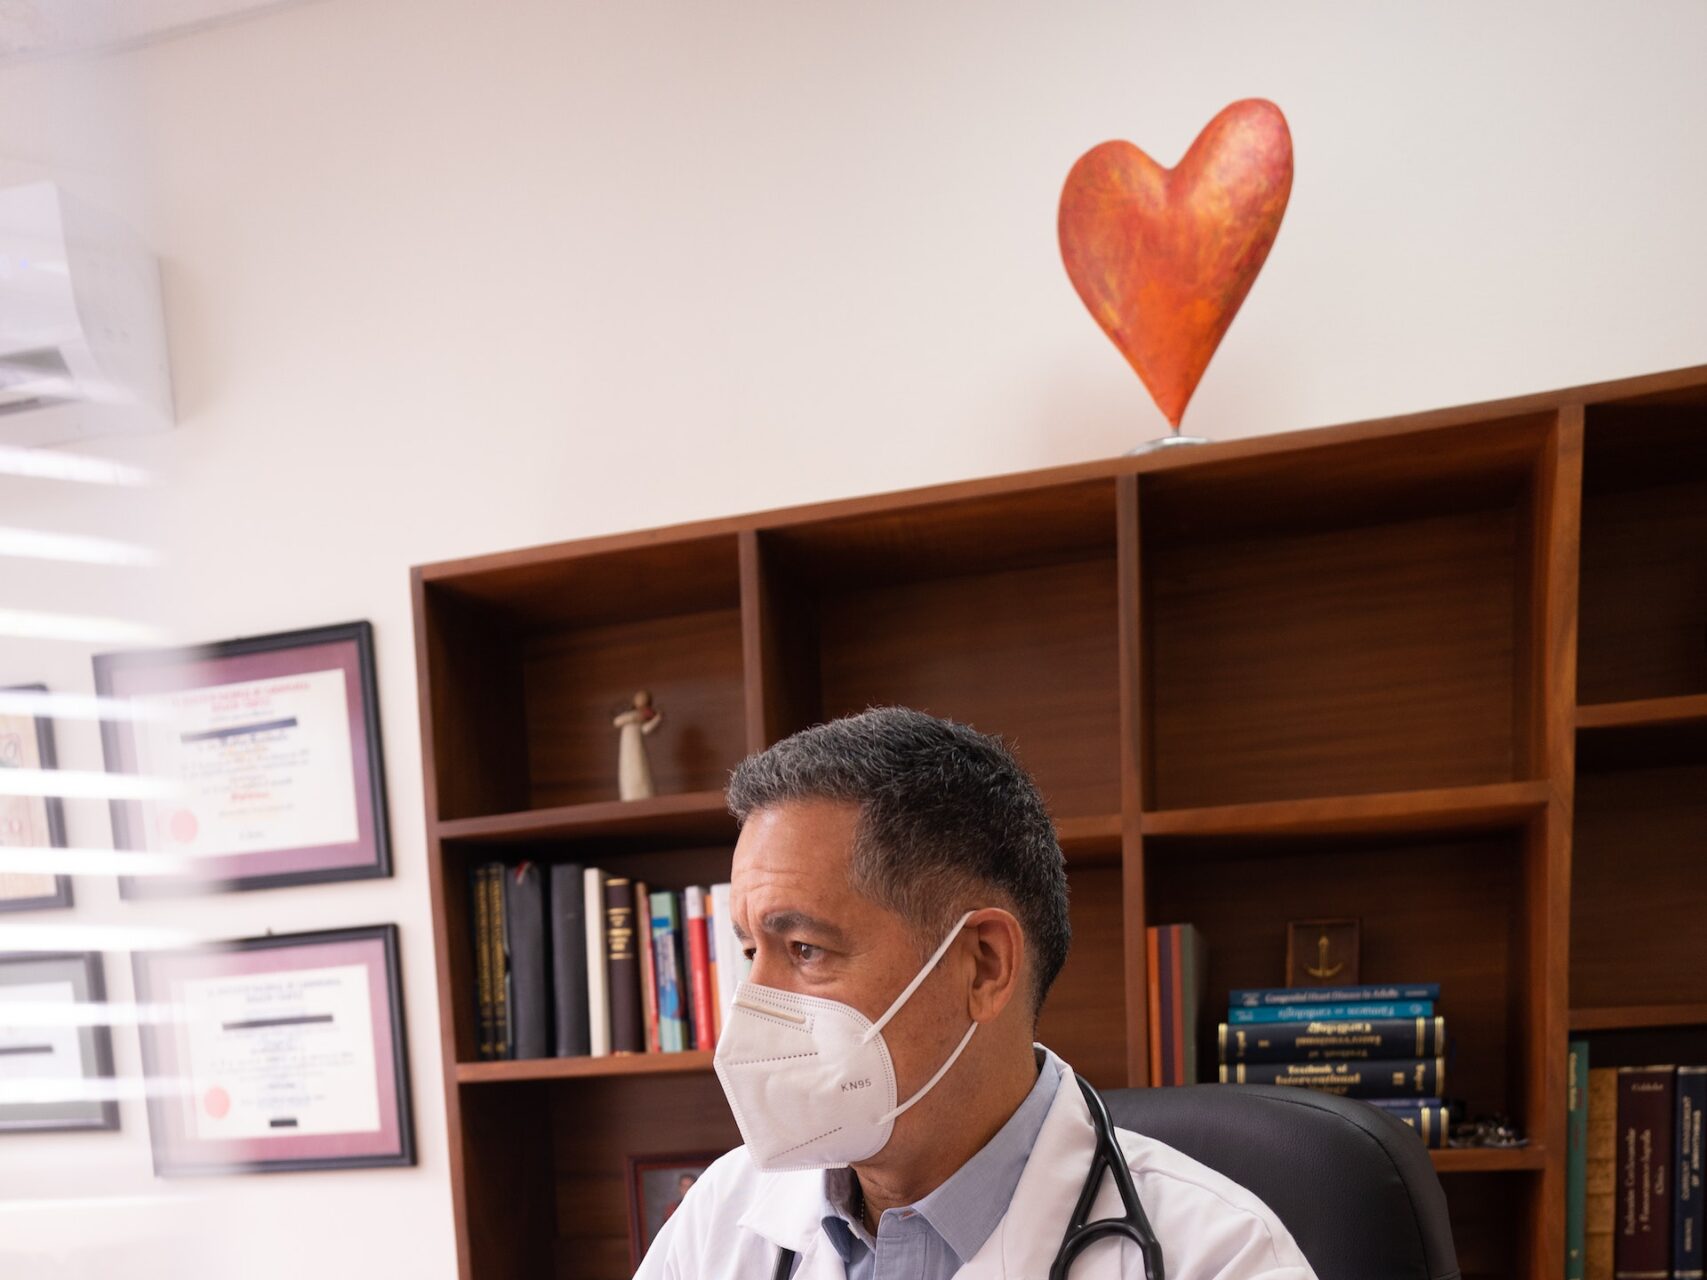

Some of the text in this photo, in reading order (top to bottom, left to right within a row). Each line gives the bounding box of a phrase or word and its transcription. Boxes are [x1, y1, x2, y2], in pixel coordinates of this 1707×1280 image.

[1306, 1022, 1371, 1034] Cardiology
[1295, 1035, 1381, 1047] Interventional
[1287, 1064, 1332, 1075] Textbook
[840, 1078, 872, 1092] KN95
[1275, 1072, 1361, 1086] Interventional
